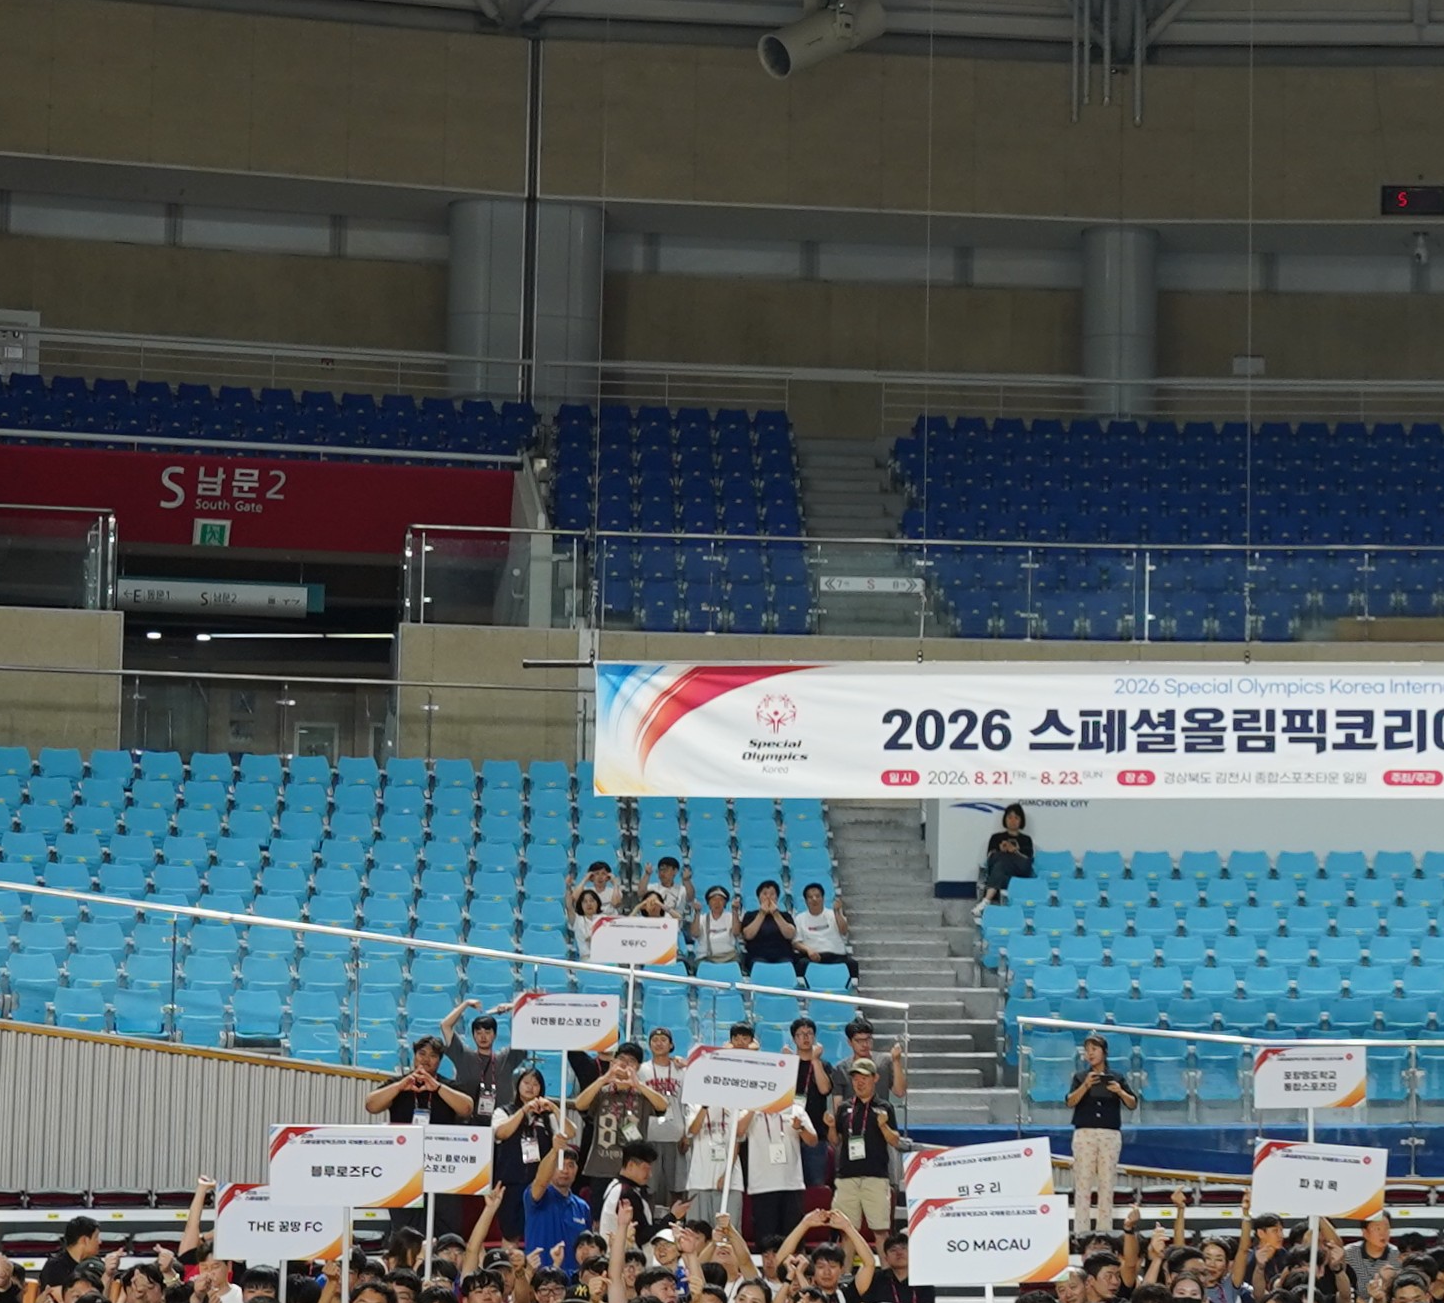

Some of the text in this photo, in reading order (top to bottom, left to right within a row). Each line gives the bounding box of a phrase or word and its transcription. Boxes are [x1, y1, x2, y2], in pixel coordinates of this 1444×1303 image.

[160, 466, 287, 509] S 남문2
[195, 499, 263, 513] South Gate
[867, 578, 875, 590] S
[133, 589, 142, 603] E
[200, 592, 209, 606] S
[1114, 678, 1158, 695] 2026
[1164, 678, 1232, 698] Special
[1238, 678, 1325, 698] Olympics
[1330, 678, 1385, 695] Korea
[881, 708, 1012, 751] 2026
[749, 739, 802, 750] Special
[742, 751, 808, 762] Olympics
[762, 764, 789, 774] Korea
[889, 772, 912, 784] 일시
[928, 771, 970, 785] 2026.
[974, 771, 988, 785] 8.
[1040, 771, 1055, 785] 8.
[1164, 771, 1211, 785] 경상북도
[1215, 771, 1251, 785] 김천시
[1255, 771, 1339, 785] 종합스포츠타운
[1018, 799, 1089, 808] GIMCHEON CITY
[311, 1165, 382, 1178] 블루로즈FC
[247, 1221, 275, 1232] THE
[304, 1221, 323, 1231] FC
[947, 1238, 1031, 1253] SO MACAU
